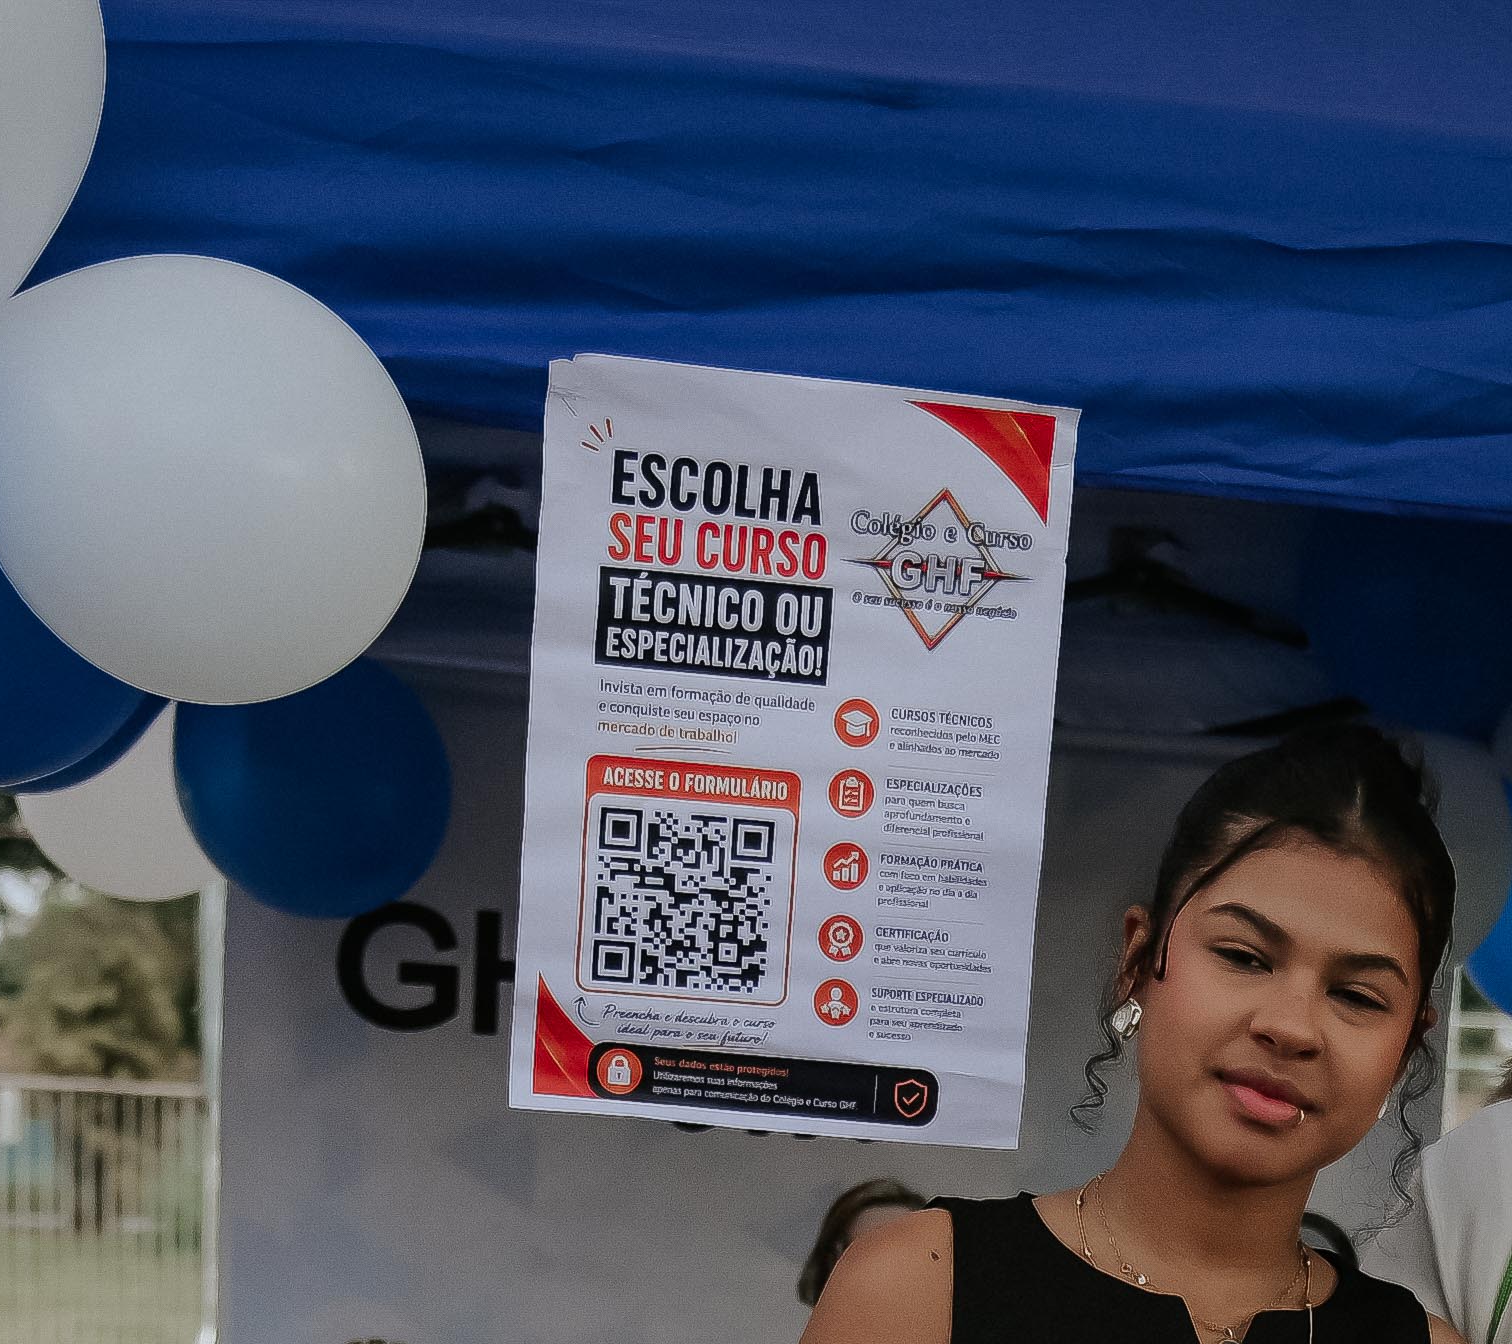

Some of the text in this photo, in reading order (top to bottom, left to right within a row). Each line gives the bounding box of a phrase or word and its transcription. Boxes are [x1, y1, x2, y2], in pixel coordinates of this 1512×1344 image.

[611, 450, 822, 526] ESCOLHA
[851, 510, 1033, 550] Colégio e Curso
[608, 513, 827, 580] SEU CURSO
[891, 551, 985, 595] GHF
[609, 572, 823, 637] TÉCNICO OU
[852, 592, 862, 604] O
[863, 595, 883, 606] seu
[605, 627, 823, 678] ESPECIALIZAÇÃO!
[600, 679, 815, 711] Invista em formação de qualidade
[599, 702, 760, 726] e conquiste seu espaço no
[891, 708, 993, 728] CURSOS TÉCNICOS
[597, 721, 737, 744] mercado de trabalho!
[890, 727, 1001, 744] reconhecidos pelo MEC
[889, 742, 895, 750] e
[897, 742, 942, 754] alinhados
[959, 749, 999, 759] mercado
[603, 766, 788, 800] ACESSE O FORMULÁRIO
[887, 778, 982, 797] ESPECIALIZAÇÕES
[885, 796, 965, 810] para quem busca
[884, 811, 962, 825] aprofundamento
[883, 823, 984, 841] diferencial profissional
[880, 854, 983, 873] FORMAÇÃO PRÁTICA
[876, 927, 948, 944] CERTIFICAÇÃO
[893, 944, 927, 954] valoriza
[872, 988, 983, 1006] SUPORTE ESPECIALIZADO
[602, 1004, 776, 1028] Preencha e descubra o curso
[617, 1022, 767, 1046] ideal para o seu futuro!
[654, 1057, 789, 1077] Seus dados estão protegidos!
[653, 1086, 682, 1095] apenas
[683, 1088, 702, 1098] para
[773, 1095, 803, 1107] Colégio
[814, 1098, 837, 1109] Curso
